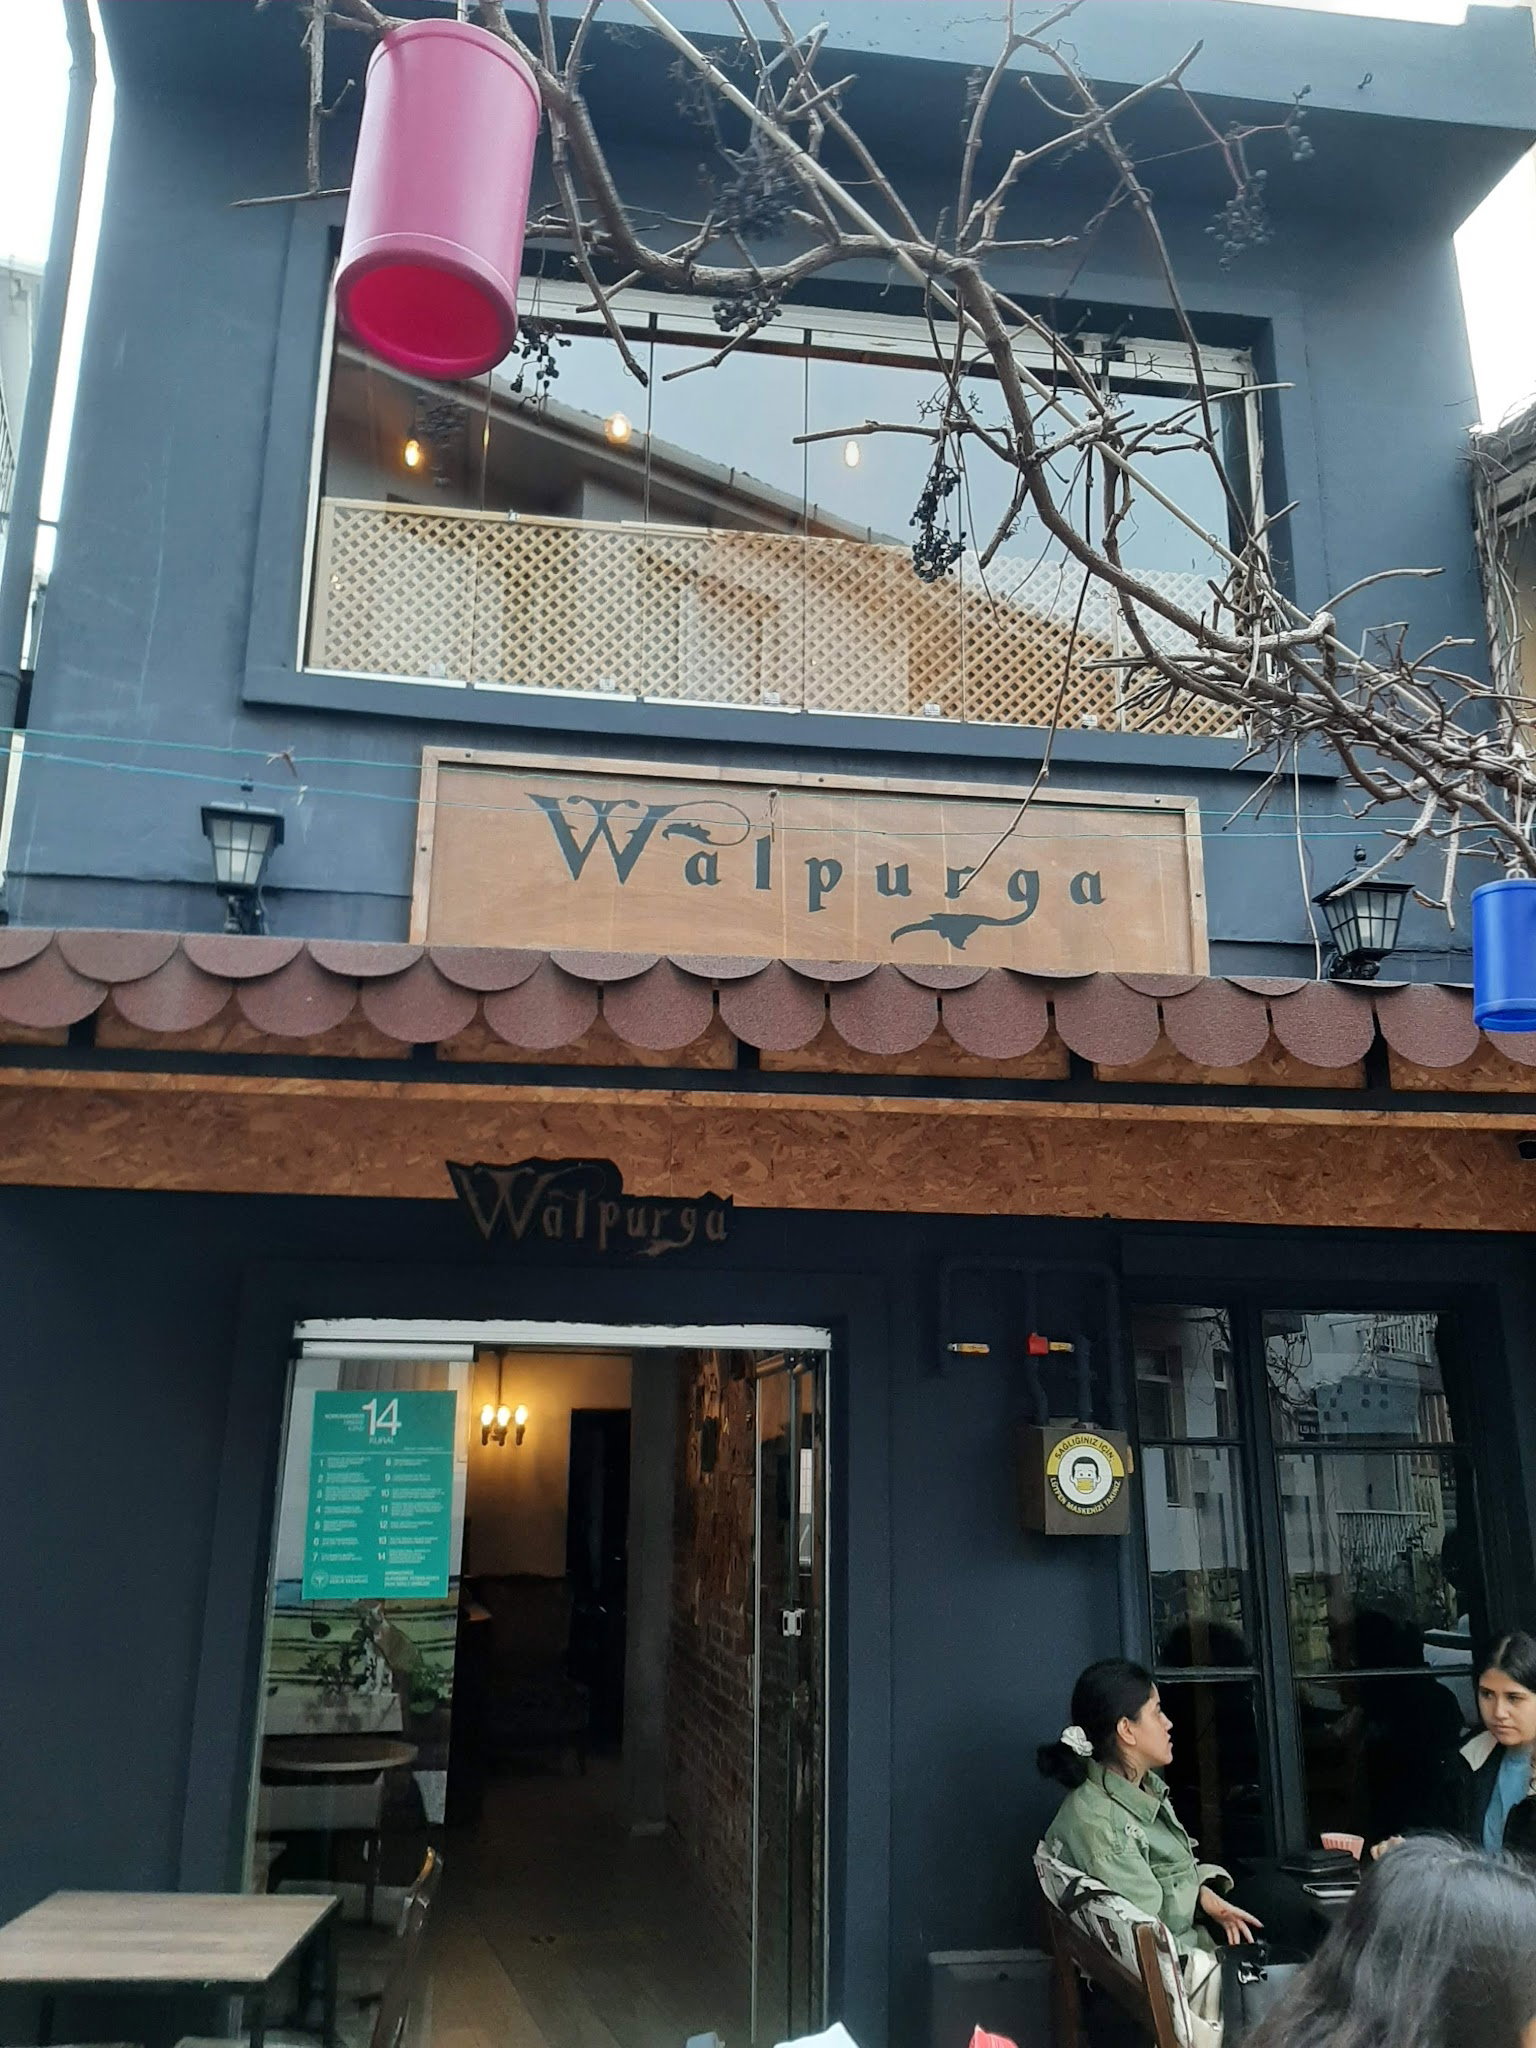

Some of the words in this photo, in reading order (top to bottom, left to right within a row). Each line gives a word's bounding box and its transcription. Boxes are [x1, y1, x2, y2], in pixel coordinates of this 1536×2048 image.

[524, 793, 1107, 950] Walpurga
[452, 1164, 729, 1257] Walpurga
[361, 1397, 402, 1436] 14
